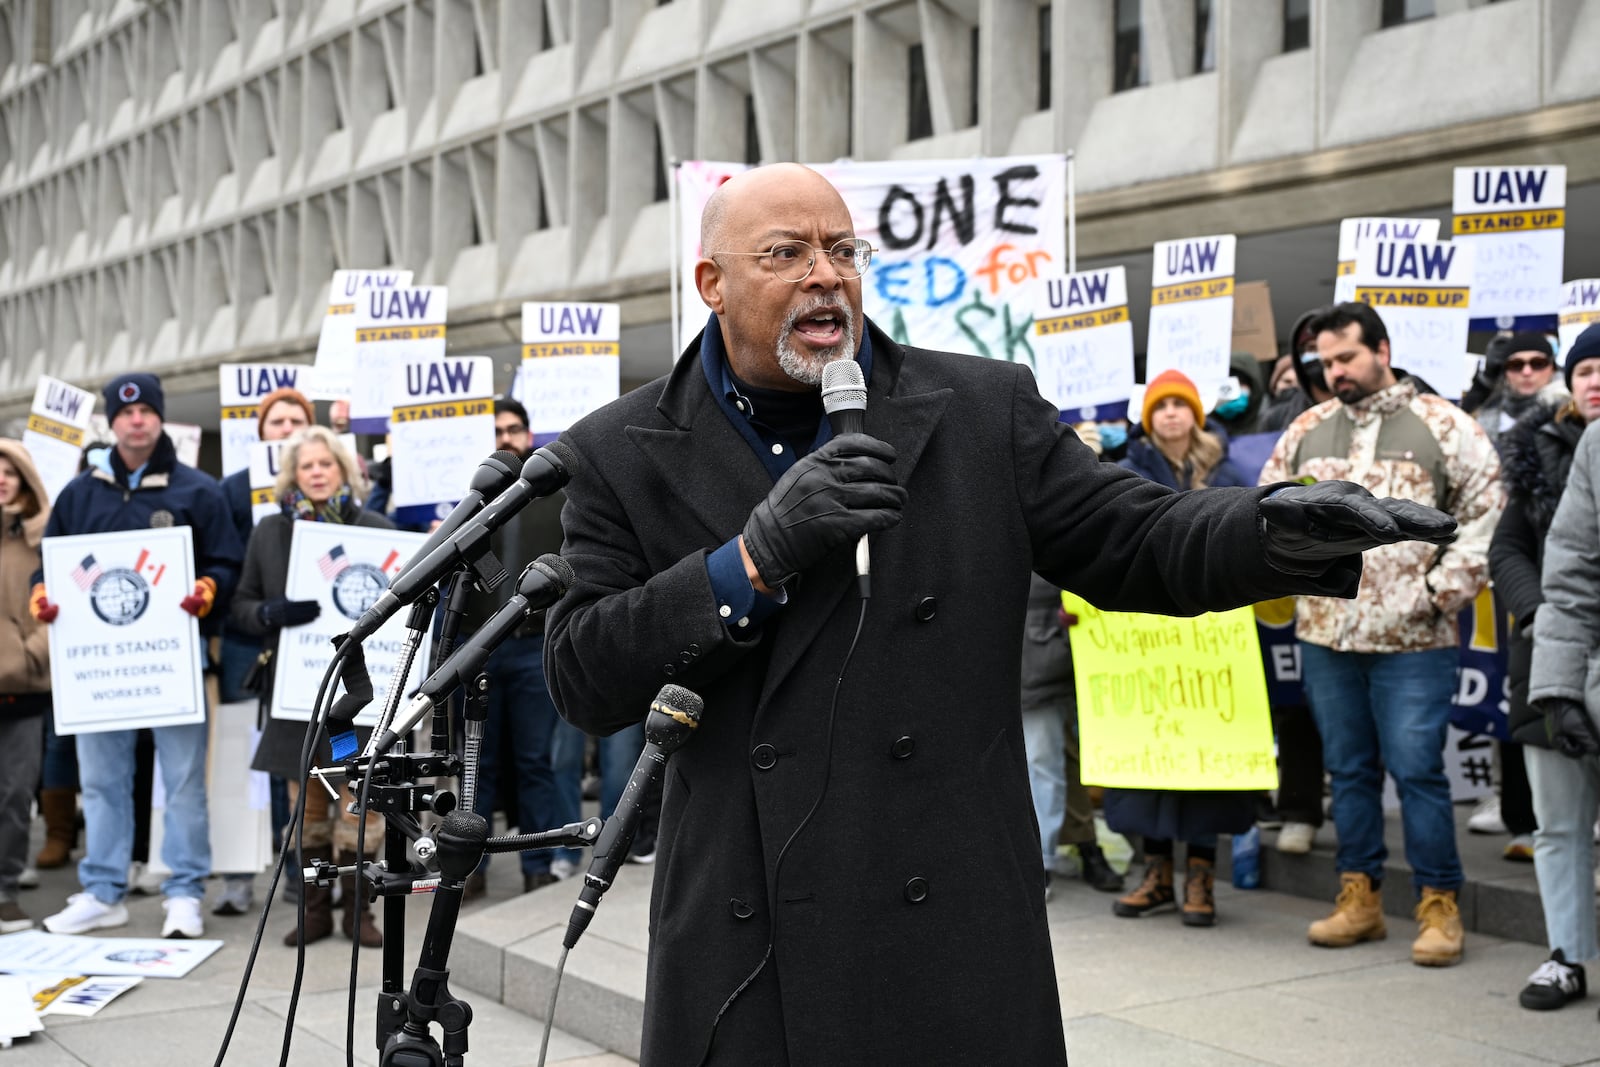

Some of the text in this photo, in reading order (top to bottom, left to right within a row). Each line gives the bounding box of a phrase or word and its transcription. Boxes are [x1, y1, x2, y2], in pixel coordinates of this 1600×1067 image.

[1473, 170, 1547, 204] UAW
[878, 165, 1040, 250] ONE
[1460, 213, 1558, 231] STAND UP
[974, 243, 1052, 294] for
[1168, 240, 1220, 276] UAW
[1376, 242, 1456, 280] UAW
[1048, 272, 1109, 309] UAW
[1158, 282, 1228, 302] STAND UP
[1360, 291, 1465, 306] STAND UP
[1567, 284, 1600, 306] AW
[370, 290, 431, 319] UAW
[359, 325, 439, 342] STAND UP
[540, 306, 602, 335] UAW
[1040, 310, 1123, 335] STAND UP
[529, 345, 613, 358] STAND UP
[238, 367, 297, 397] UAW
[407, 361, 474, 396] UAW
[45, 383, 84, 421] UAW
[228, 408, 260, 418] STA
[397, 403, 487, 421] STAND UP
[66, 637, 181, 660] IFPTE STANDS
[1191, 619, 1248, 655] have
[74, 663, 175, 682] WITH FEDERAL
[91, 685, 162, 702] WORKERS
